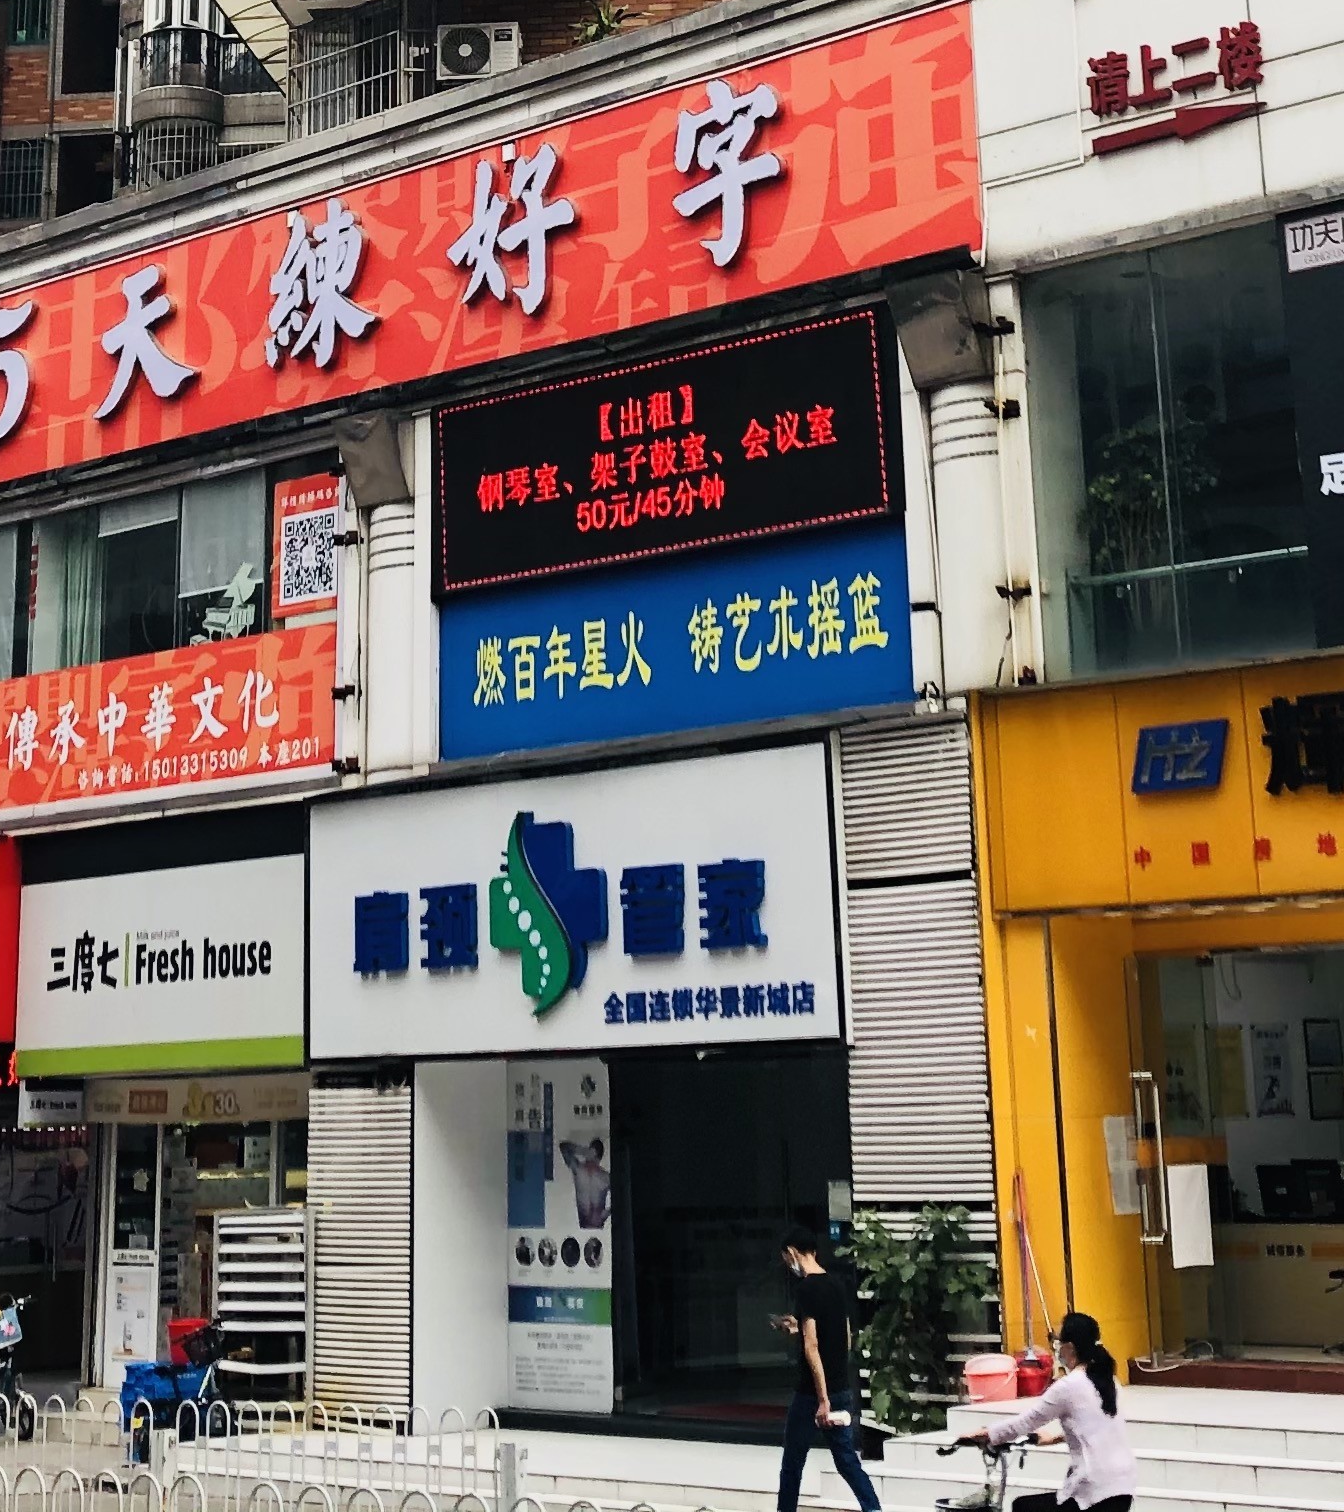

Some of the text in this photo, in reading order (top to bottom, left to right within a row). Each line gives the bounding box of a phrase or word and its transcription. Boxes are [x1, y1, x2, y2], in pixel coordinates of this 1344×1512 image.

[1086, 21, 1264, 117] 请上二楼
[576, 474, 726, 534] 50元/45分钟
[473, 572, 889, 708] 燃百年星火 铸艺术摇篮
[6, 669, 280, 772] 傳承中華文化
[135, 939, 194, 985] Fresh
[203, 936, 272, 980] house
[604, 981, 816, 1025] 全国连锁华景新城店
